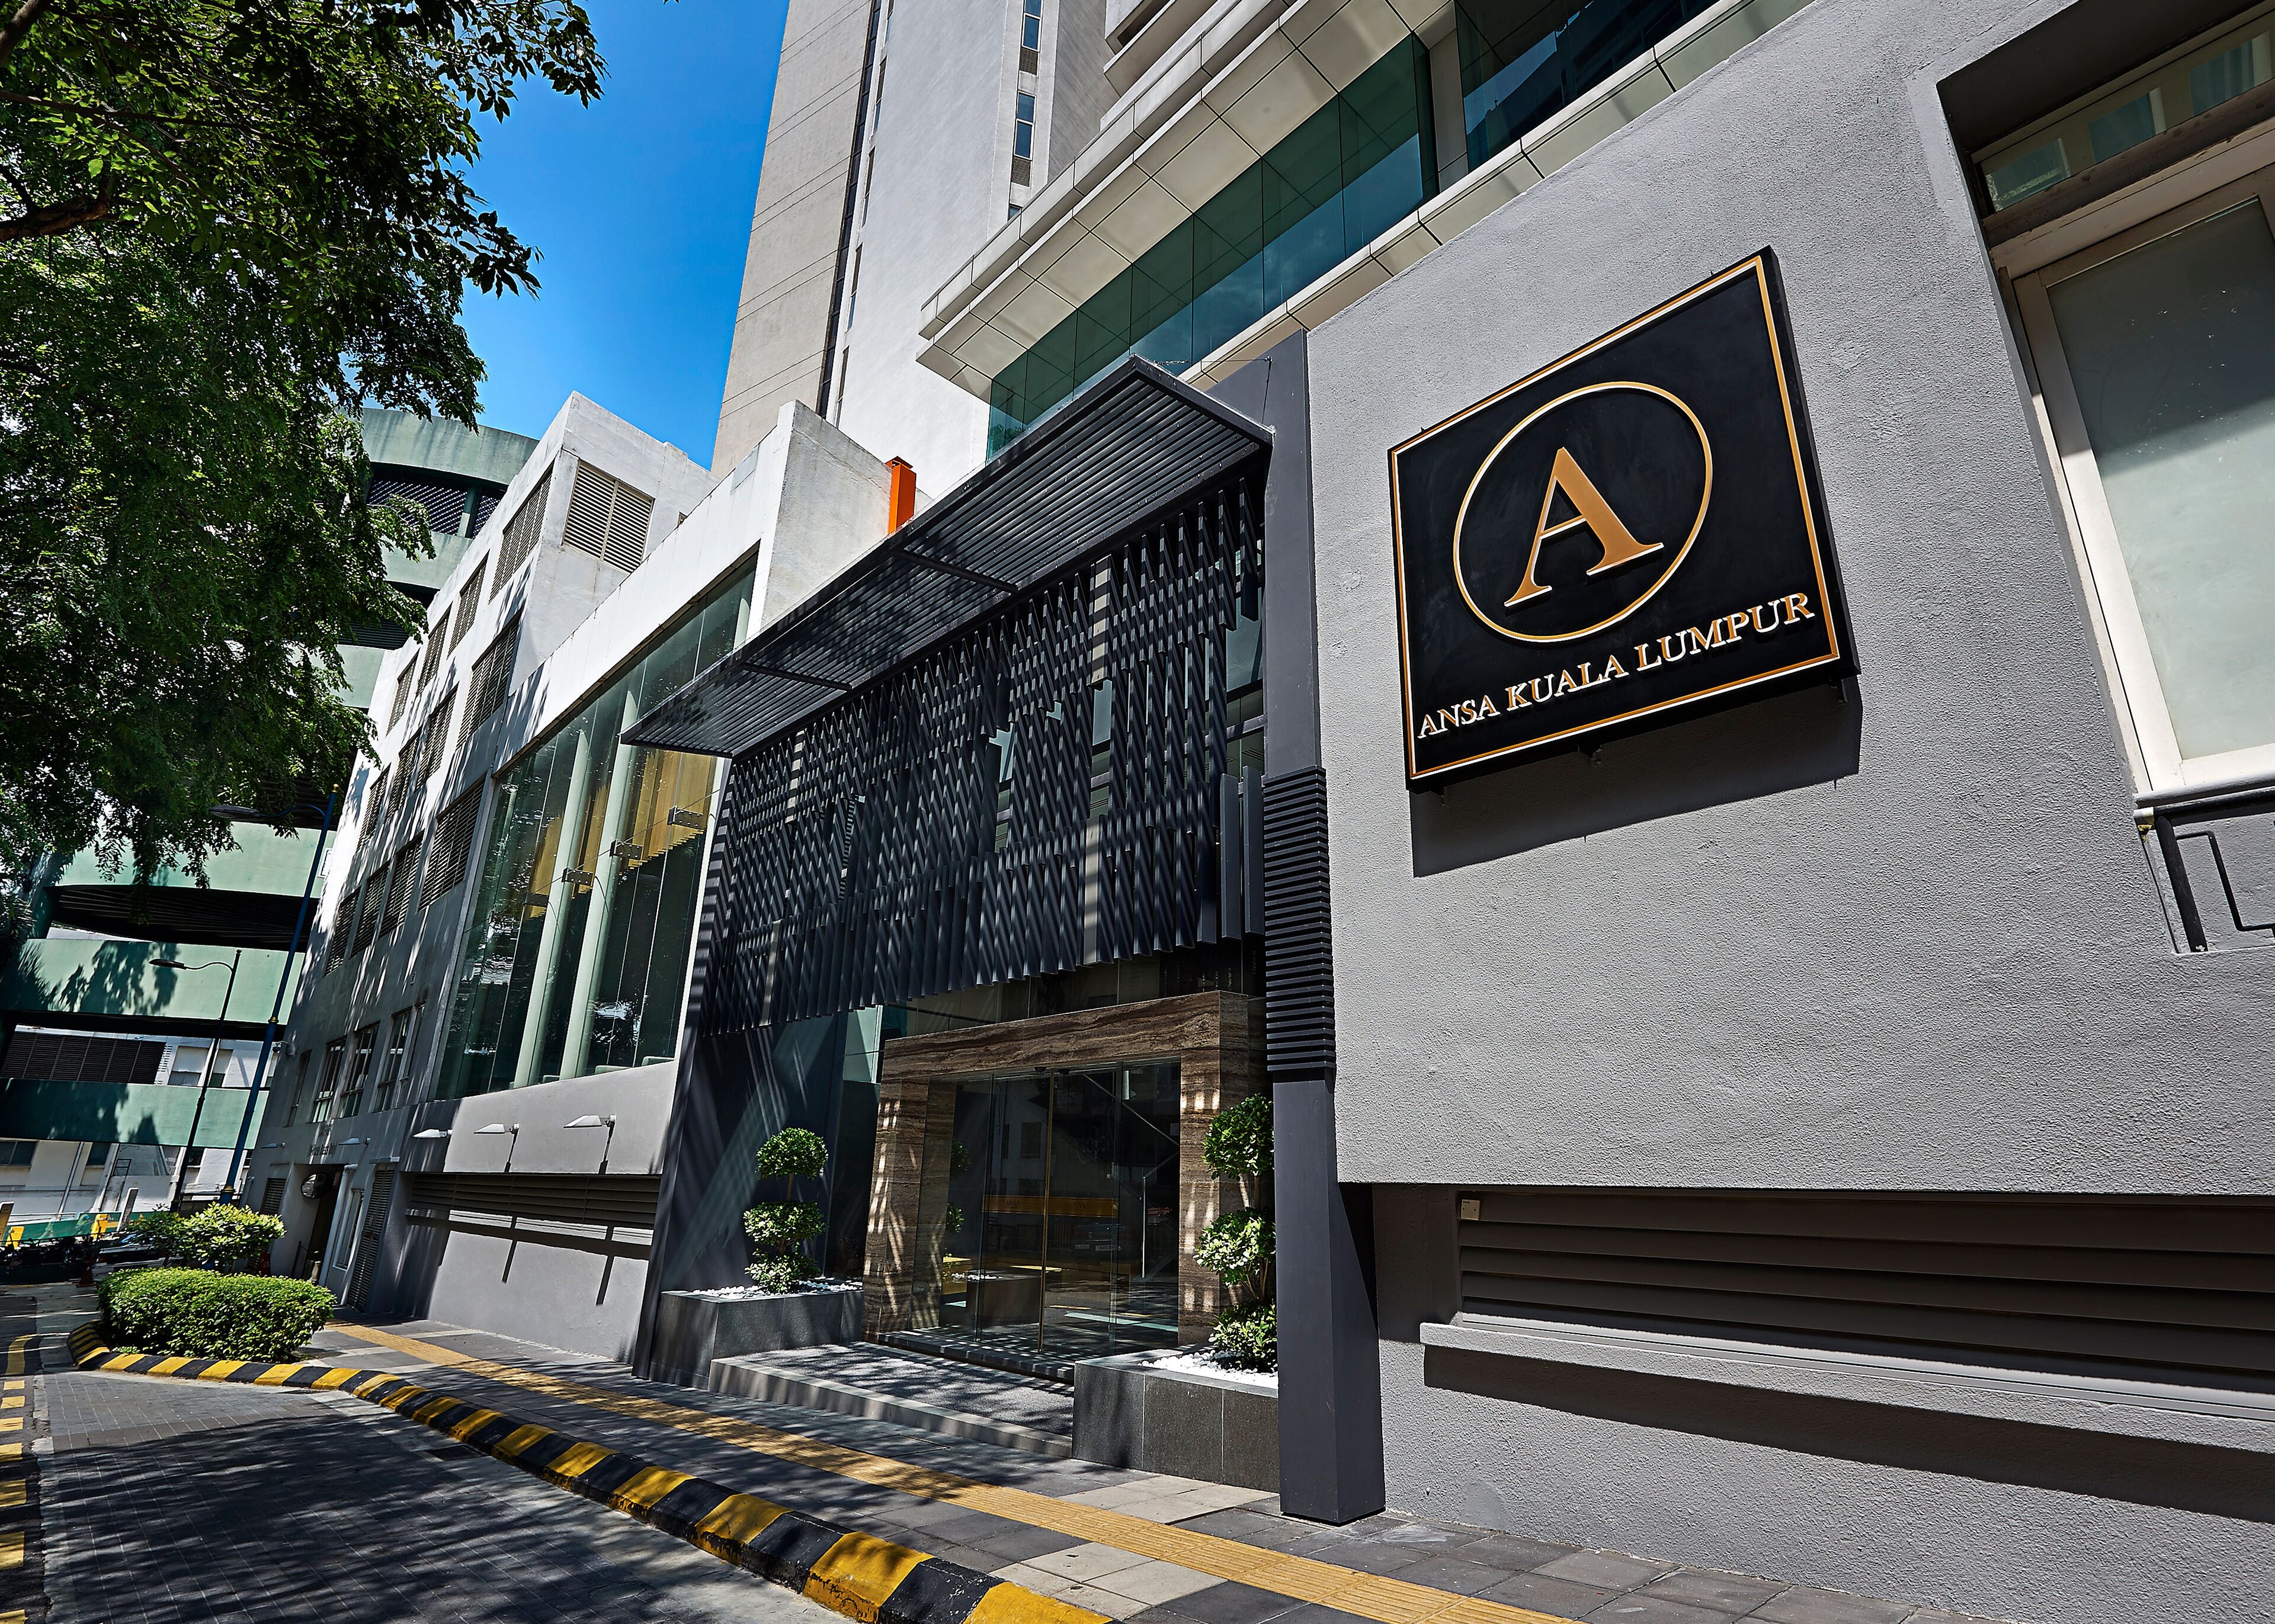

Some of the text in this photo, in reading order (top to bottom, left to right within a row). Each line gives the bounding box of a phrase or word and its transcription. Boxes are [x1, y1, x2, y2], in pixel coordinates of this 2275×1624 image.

[1504, 447, 1664, 607] A
[1417, 592, 1815, 739] ANSA KUALA LUMPUR
